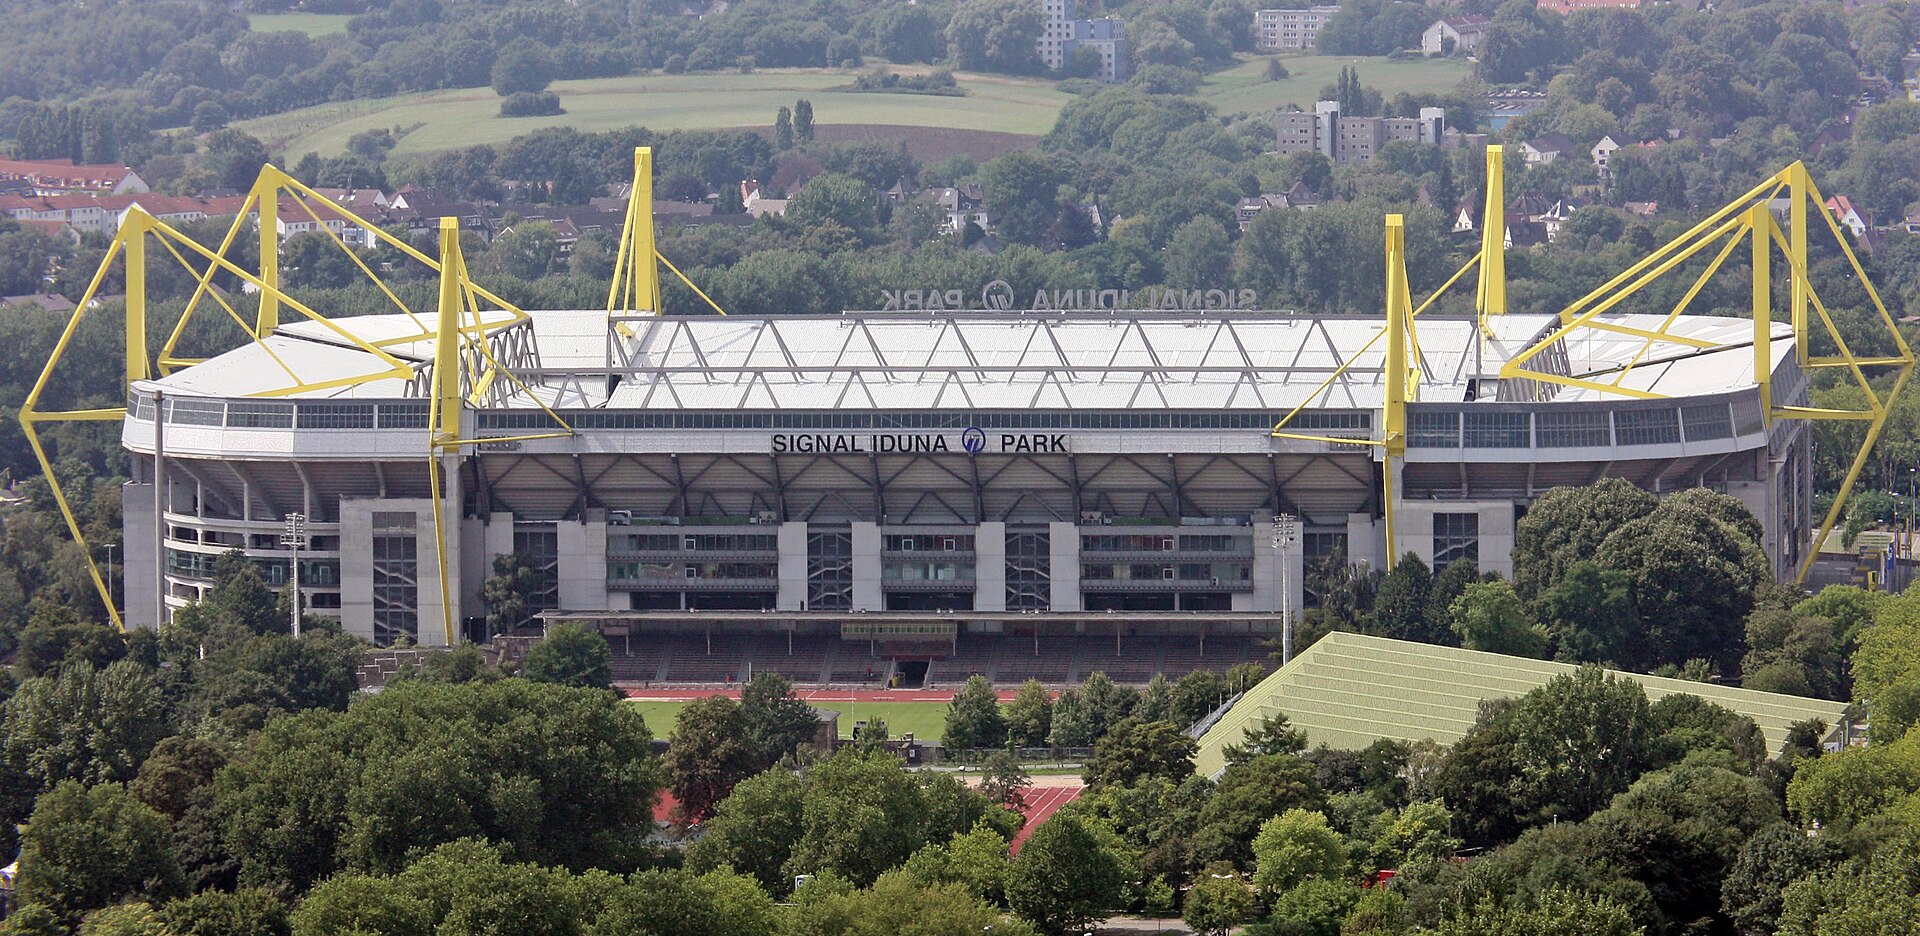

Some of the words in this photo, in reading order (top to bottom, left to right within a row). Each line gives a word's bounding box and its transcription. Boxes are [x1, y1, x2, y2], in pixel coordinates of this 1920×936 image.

[772, 434, 864, 452] SIGNAL
[872, 434, 948, 452] IDUNA
[1001, 434, 1067, 452] PARK
